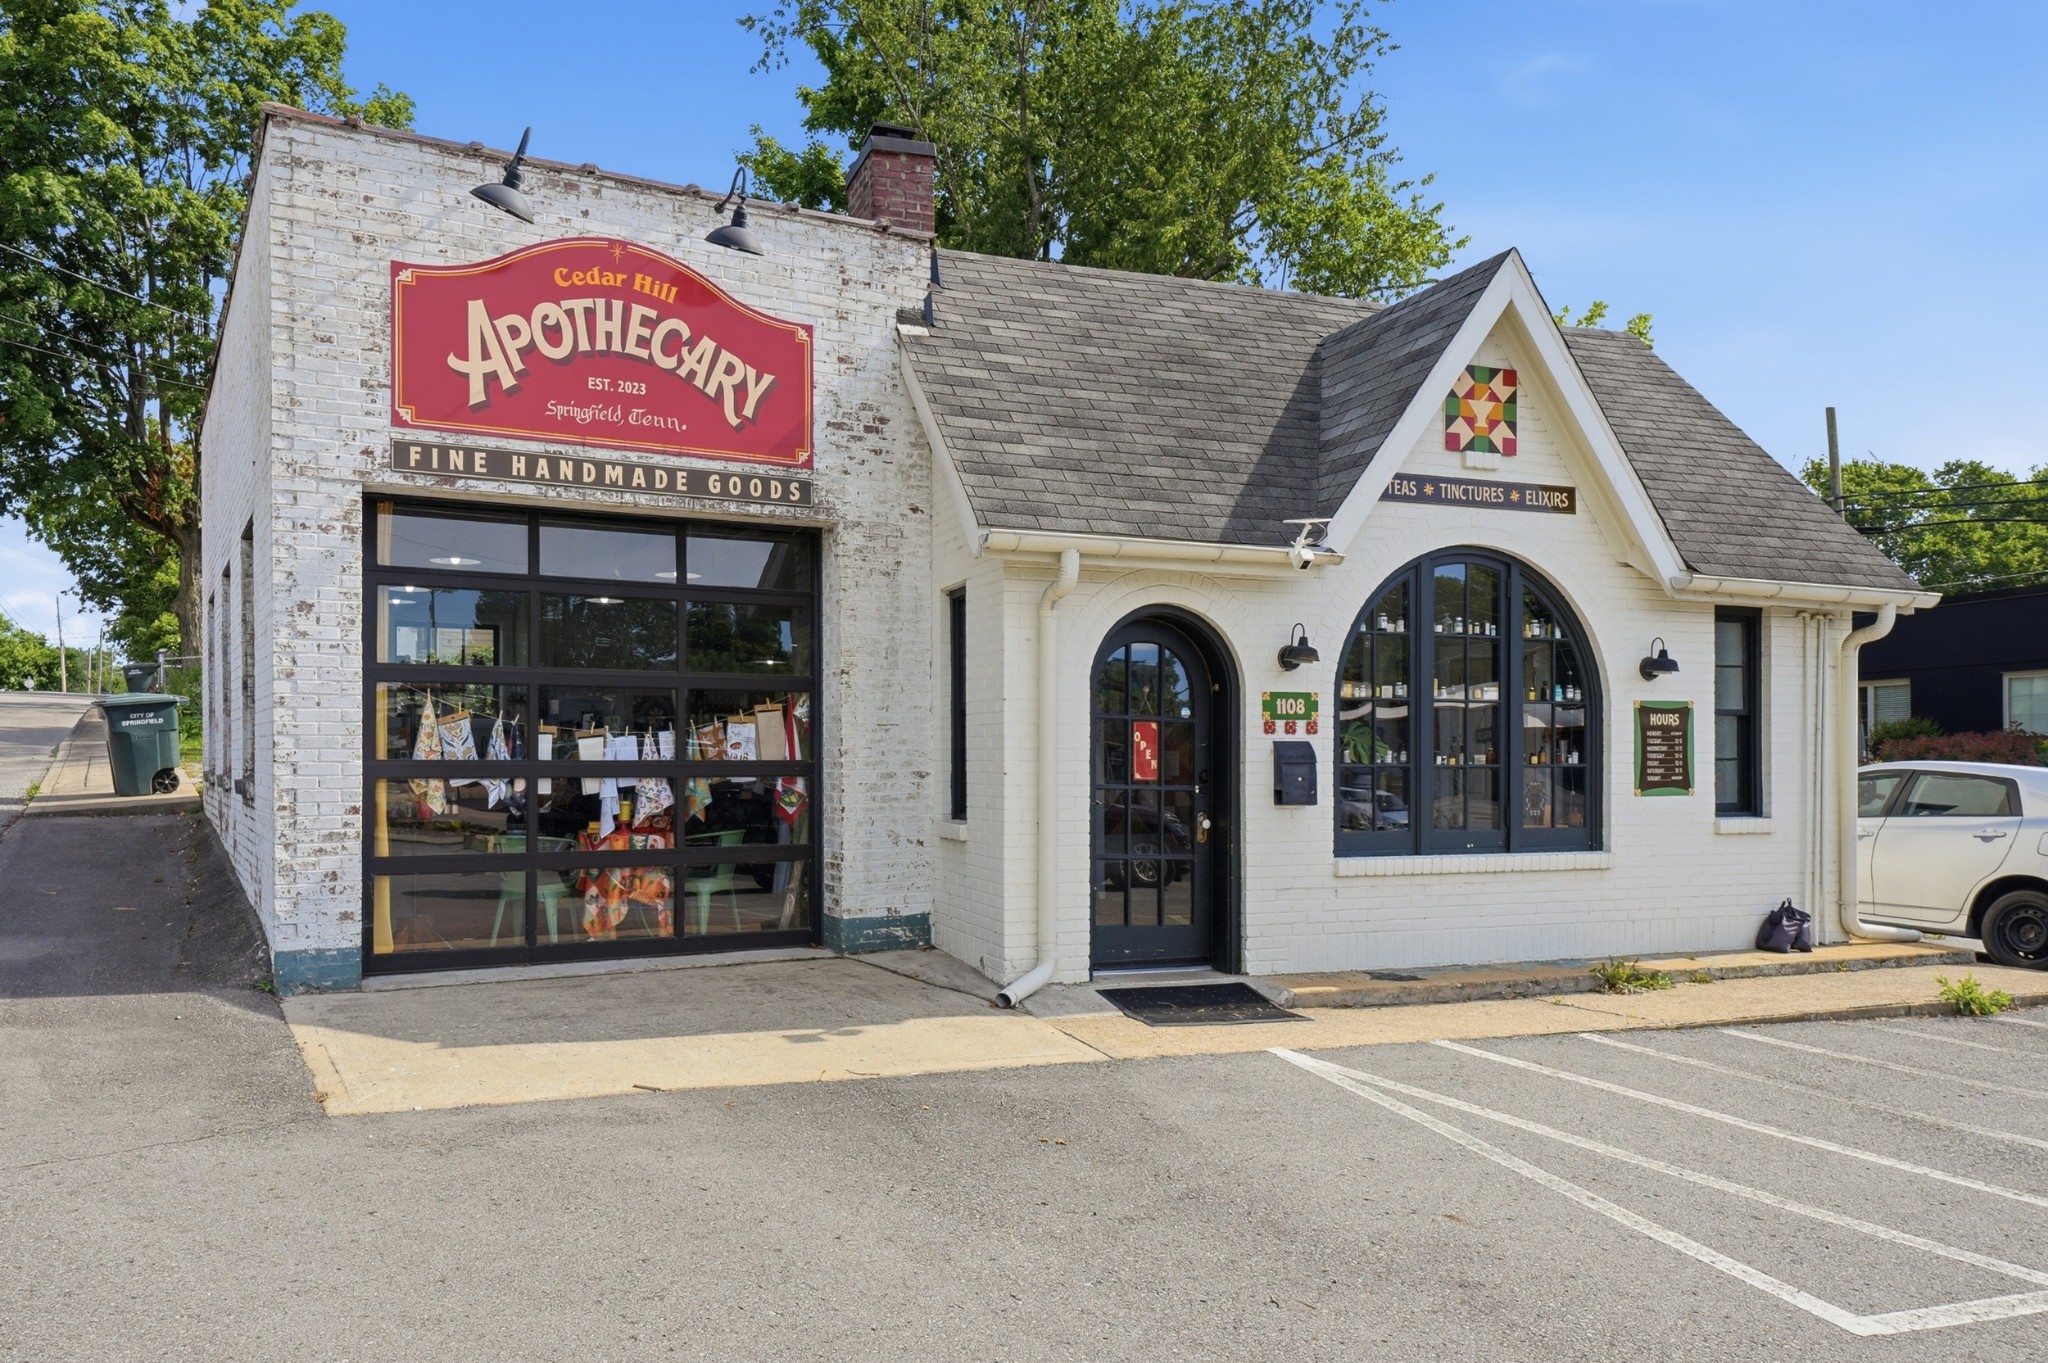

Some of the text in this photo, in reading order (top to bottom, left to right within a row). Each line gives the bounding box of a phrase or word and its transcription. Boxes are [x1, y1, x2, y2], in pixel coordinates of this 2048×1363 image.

[553, 265, 679, 305] Cedar Hill
[447, 298, 776, 428] APOTHECARY
[588, 376, 647, 396] EST. 2023
[545, 400, 688, 432] Springfield, Tenn.
[409, 446, 800, 500] FINE HANDMADE GOODS
[1388, 479, 1569, 508] TEAS TINCTURES ELIXIRS
[1276, 698, 1305, 714] 1108
[1650, 713, 1680, 726] HOURS
[1133, 732, 1157, 769] OPEN
